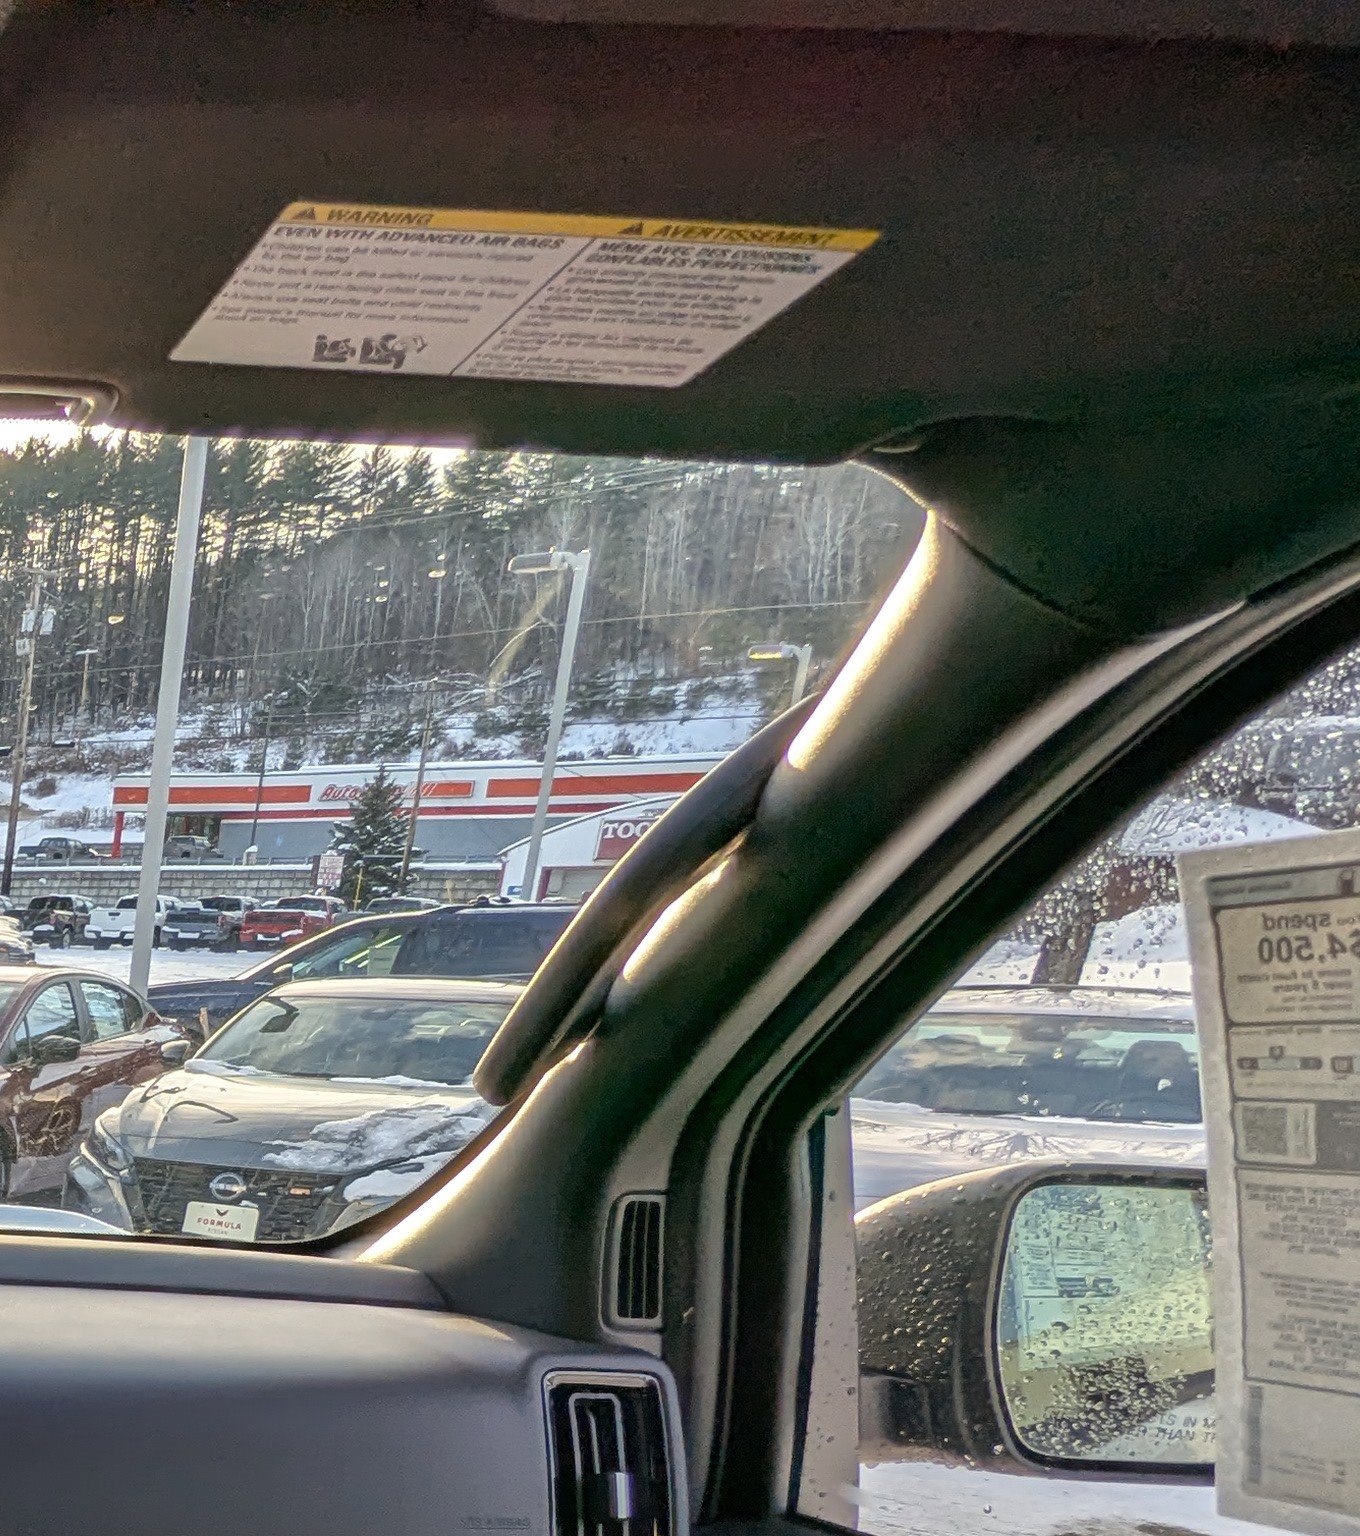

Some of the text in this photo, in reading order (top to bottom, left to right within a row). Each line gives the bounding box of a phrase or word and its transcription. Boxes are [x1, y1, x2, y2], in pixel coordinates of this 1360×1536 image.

[326, 208, 434, 226] WARNING
[272, 226, 565, 250] EVEN WITH ADVANCED AIR BAGS
[196, 1217, 243, 1231] FORMULA
